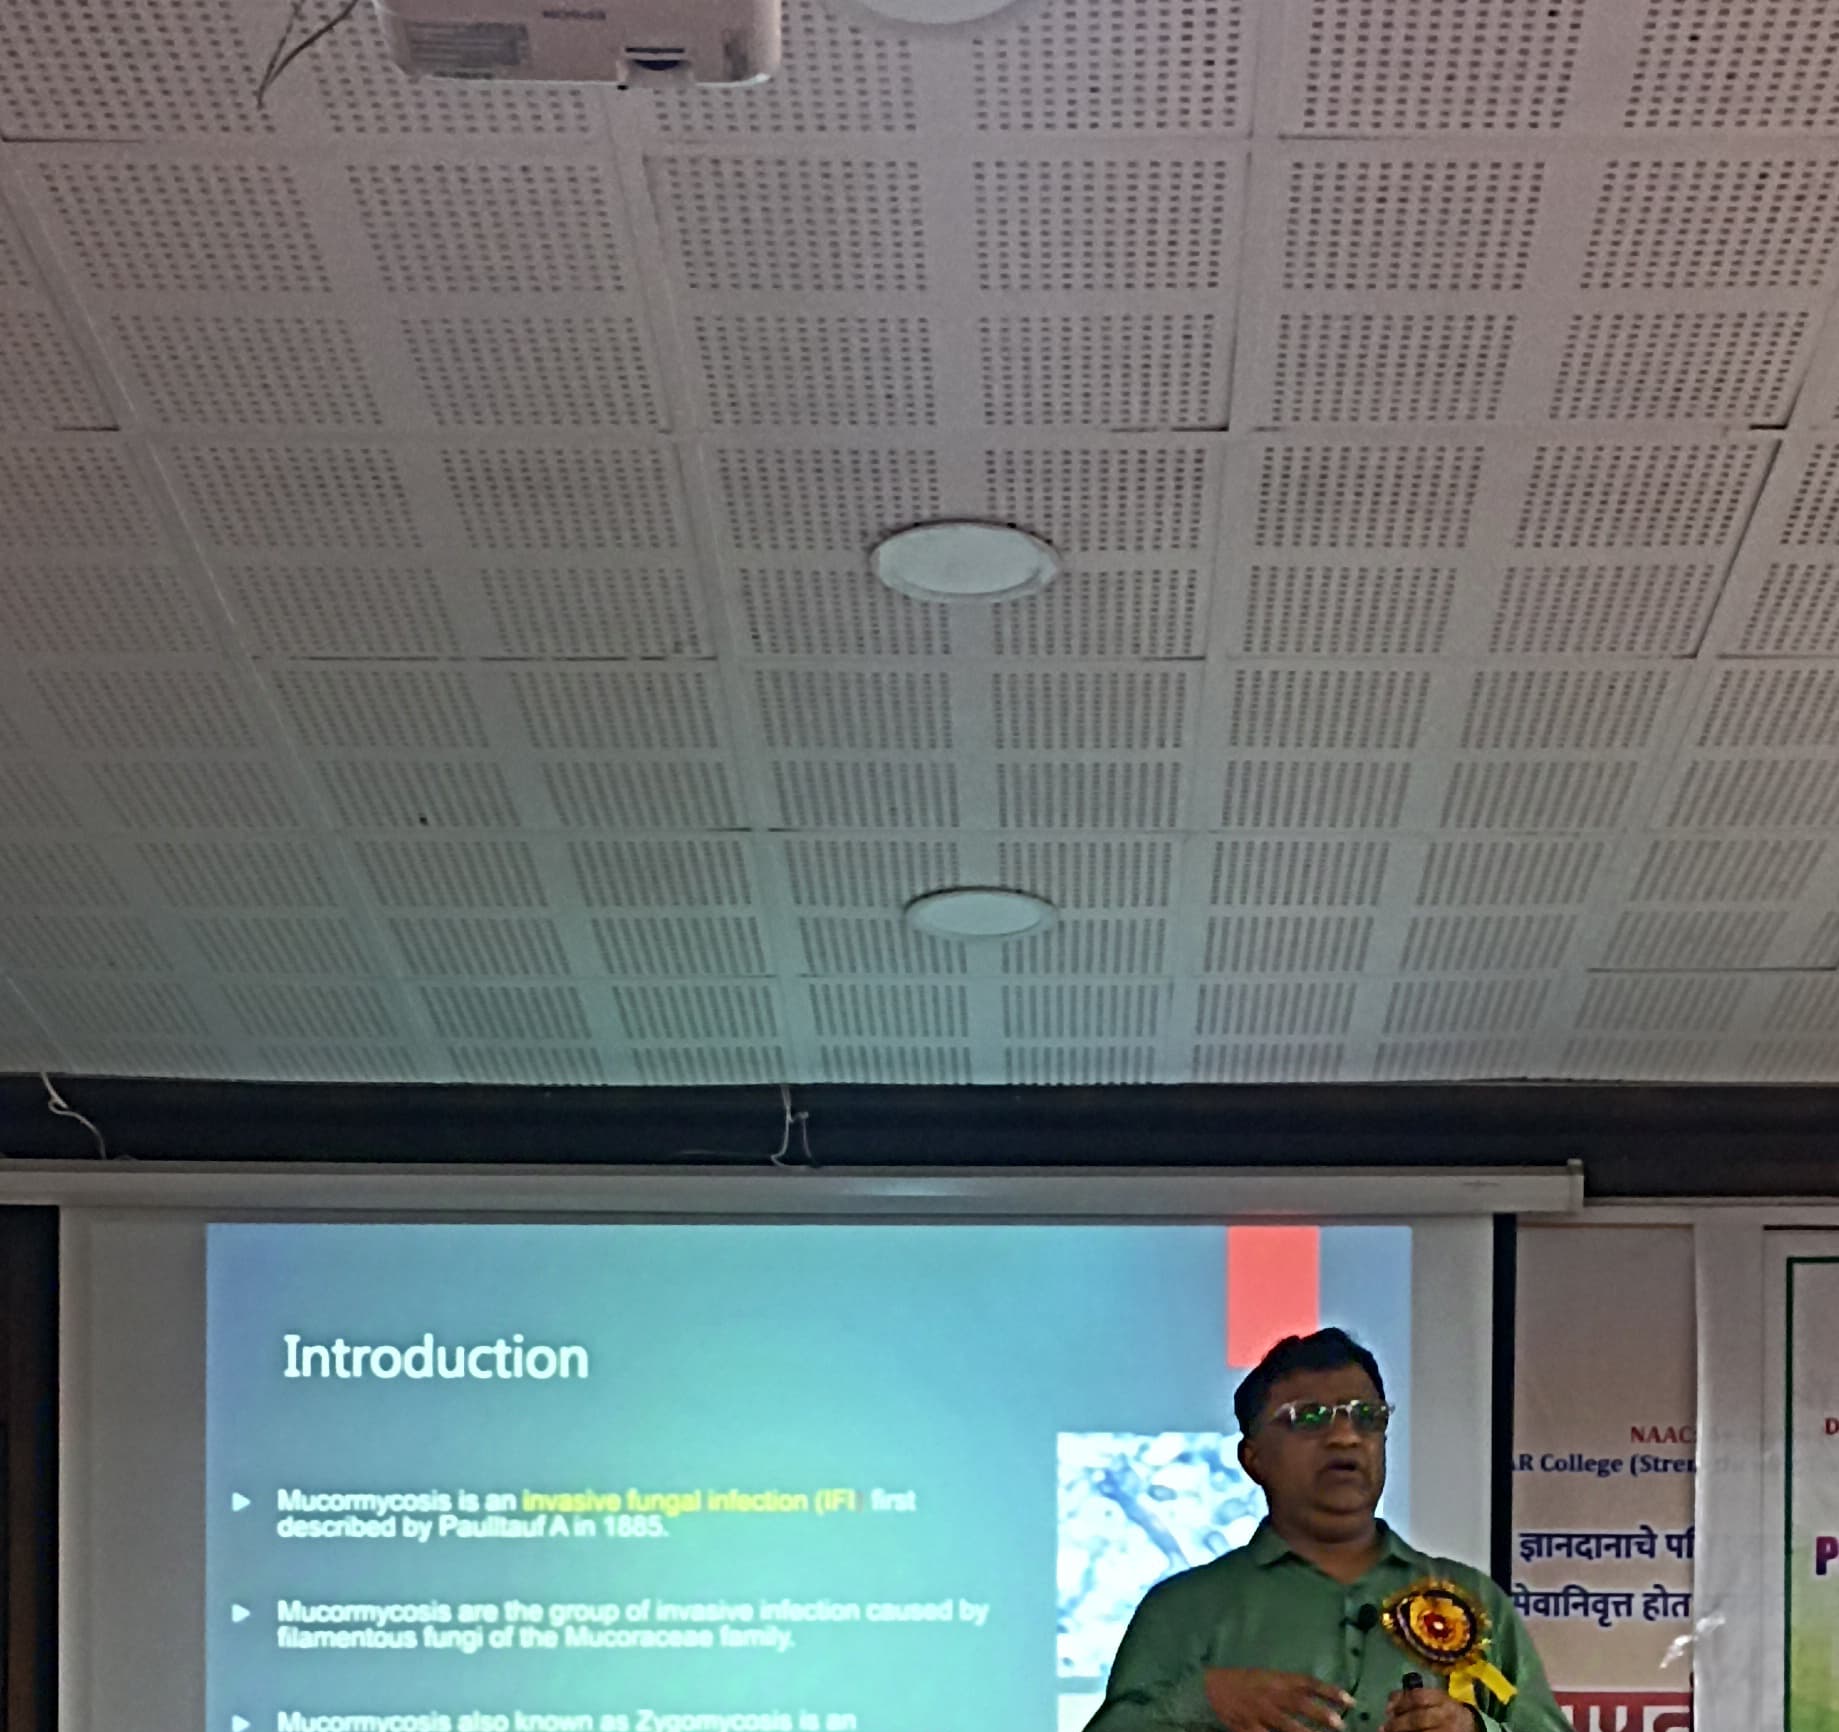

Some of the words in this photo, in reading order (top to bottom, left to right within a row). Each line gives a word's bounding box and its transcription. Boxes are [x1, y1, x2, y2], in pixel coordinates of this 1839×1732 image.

[283, 1333, 588, 1379] Introduction
[1540, 1453, 1623, 1477] College
[277, 1489, 452, 1516] Mucormycosis
[458, 1489, 480, 1512] is
[485, 1493, 517, 1512] an
[522, 1489, 621, 1512] invasive
[627, 1489, 701, 1516] fungal
[707, 1489, 808, 1512] infection
[870, 1488, 916, 1512] first
[276, 1515, 396, 1538] described
[402, 1515, 434, 1543] by
[574, 1515, 596, 1538] in
[1519, 1525, 1657, 1562] ज्ञानदानाचे
[1815, 1536, 1839, 1576] P
[277, 1600, 452, 1627] Mucormycosis
[457, 1604, 497, 1623] are
[504, 1600, 543, 1622] the
[548, 1604, 620, 1627] group
[625, 1600, 650, 1622] of
[656, 1600, 754, 1622] invasive
[760, 1599, 861, 1622] infection
[866, 1600, 953, 1621] caused
[959, 1599, 990, 1626] by
[277, 1626, 417, 1648] filamentous
[424, 1626, 482, 1653] fungi
[488, 1626, 514, 1648] of
[519, 1626, 558, 1648] the
[564, 1626, 714, 1648] Mucoraceae
[719, 1626, 795, 1653] family.
[514, 1710, 594, 1732] known
[599, 1714, 630, 1732] as
[799, 1711, 820, 1732] is
[826, 1713, 857, 1732] an
